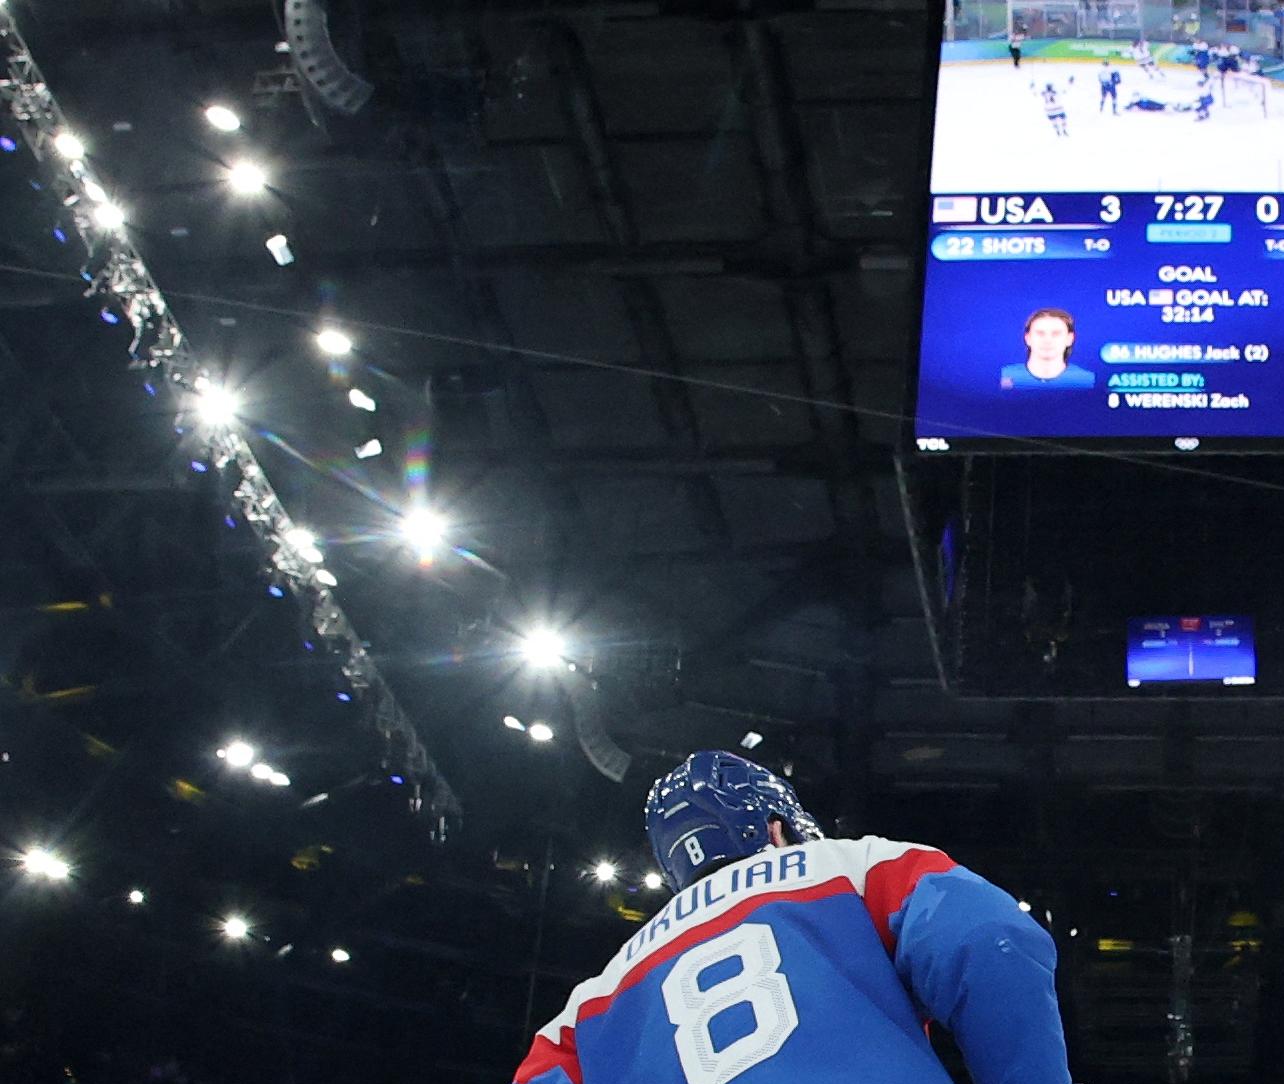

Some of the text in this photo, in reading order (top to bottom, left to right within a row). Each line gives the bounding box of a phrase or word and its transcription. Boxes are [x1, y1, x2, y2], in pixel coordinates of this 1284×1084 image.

[980, 197, 1053, 224] USA
[1100, 195, 1121, 223] 3
[1154, 195, 1224, 221] 7:27
[1256, 196, 1279, 223] 0
[947, 237, 974, 255] 22
[982, 237, 1046, 254] SHOTS
[1158, 265, 1217, 283] GOAL
[1106, 289, 1147, 306] USA
[1175, 289, 1234, 306] GOAL
[1161, 306, 1215, 323] 32:14
[1134, 344, 1202, 360] HUGHES
[1204, 345, 1240, 360] Jack
[1108, 373, 1179, 387] ASSISTED
[1125, 393, 1208, 408] WERENSKI
[1210, 393, 1250, 408] Zach
[685, 836, 705, 866] 8
